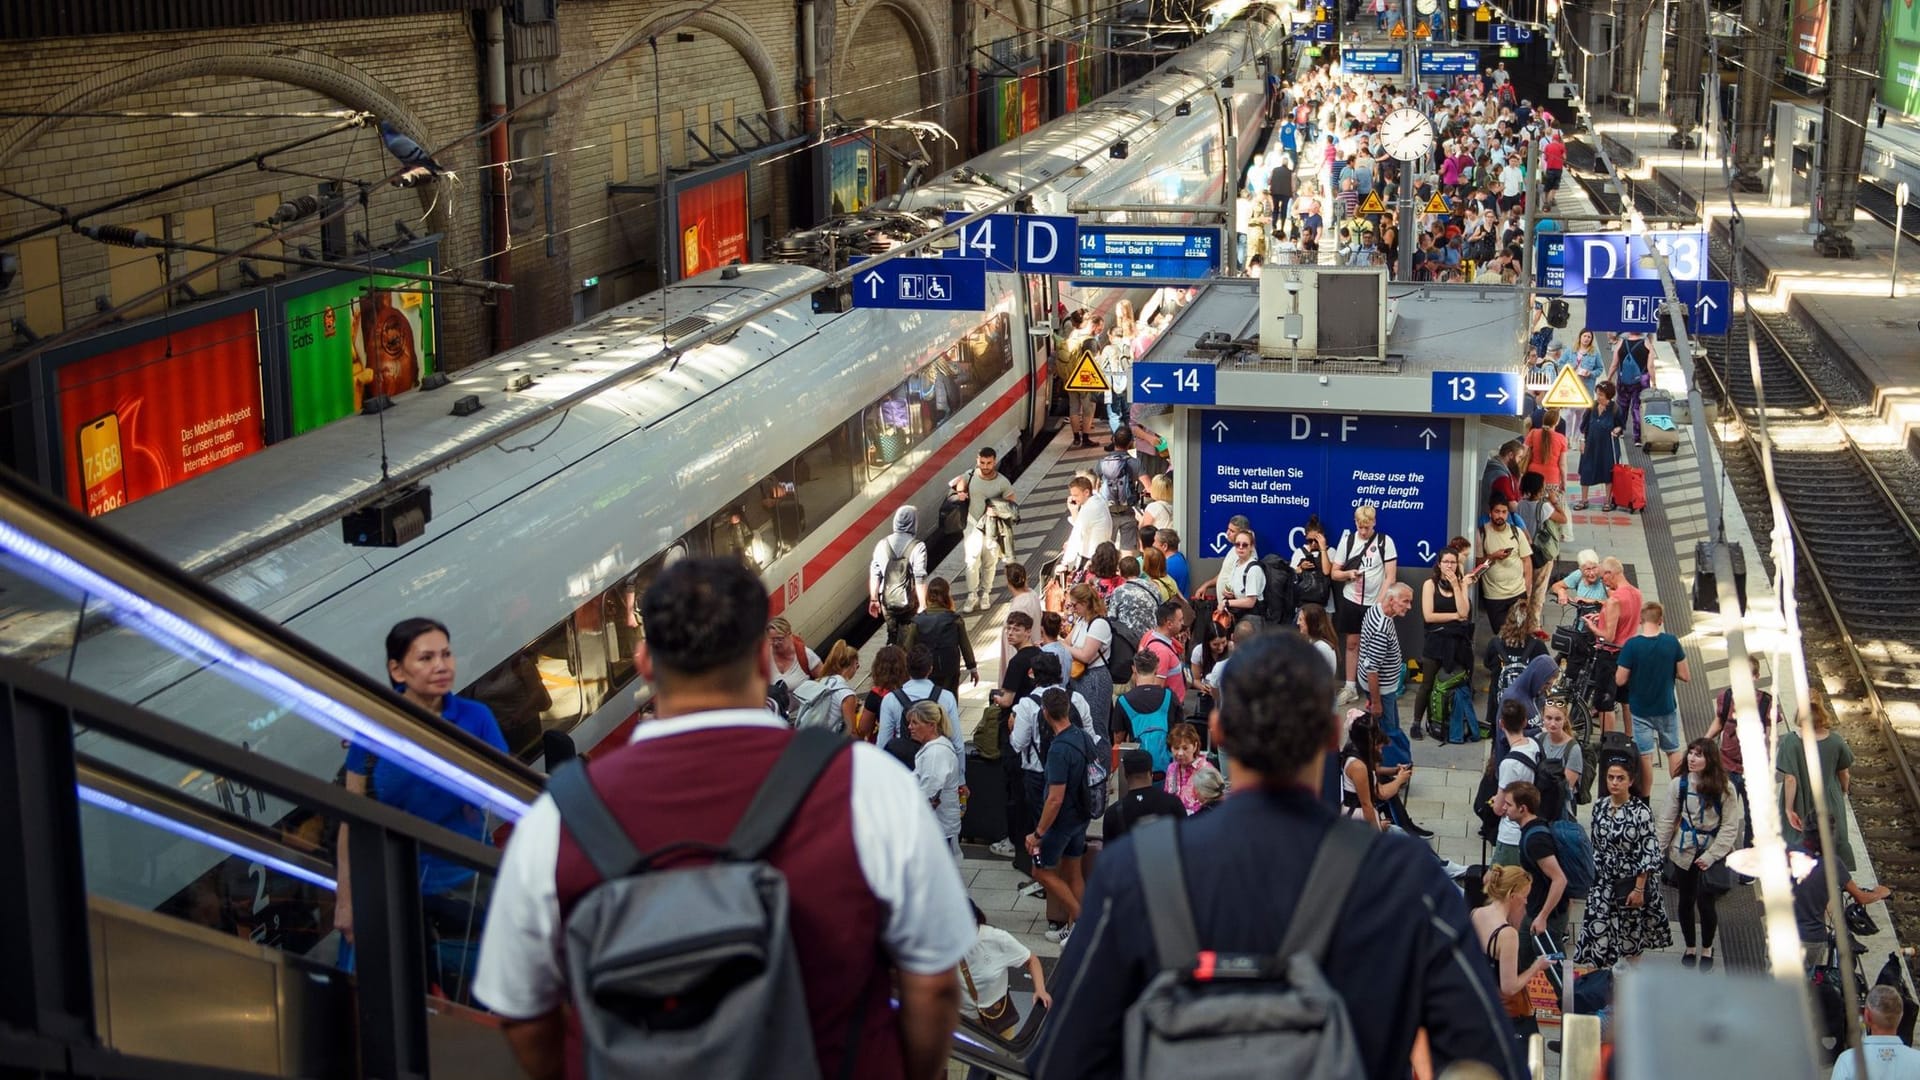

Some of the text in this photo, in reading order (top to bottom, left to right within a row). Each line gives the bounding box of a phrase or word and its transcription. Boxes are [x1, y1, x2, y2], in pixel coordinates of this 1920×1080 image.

[1317, 25, 1327, 39] E
[1496, 26, 1506, 41] E
[1027, 221, 1058, 264] D
[1080, 235, 1097, 250] 14
[1583, 240, 1617, 285] D
[292, 333, 314, 350] Eats
[1173, 368, 1200, 392] 14
[1447, 376, 1476, 401] 13
[181, 428, 194, 442] Das
[1291, 414, 1311, 440] D
[1341, 416, 1359, 442] F
[1217, 465, 1304, 478] Bitte verteilen Sie
[1352, 470, 1425, 483] Please use the
[1228, 479, 1292, 491] sich auf dem
[1356, 484, 1420, 498] entire length
[1210, 493, 1310, 508] gesamten Bahnsteig
[1351, 497, 1424, 511] of the platform
[248, 862, 270, 916] 2
